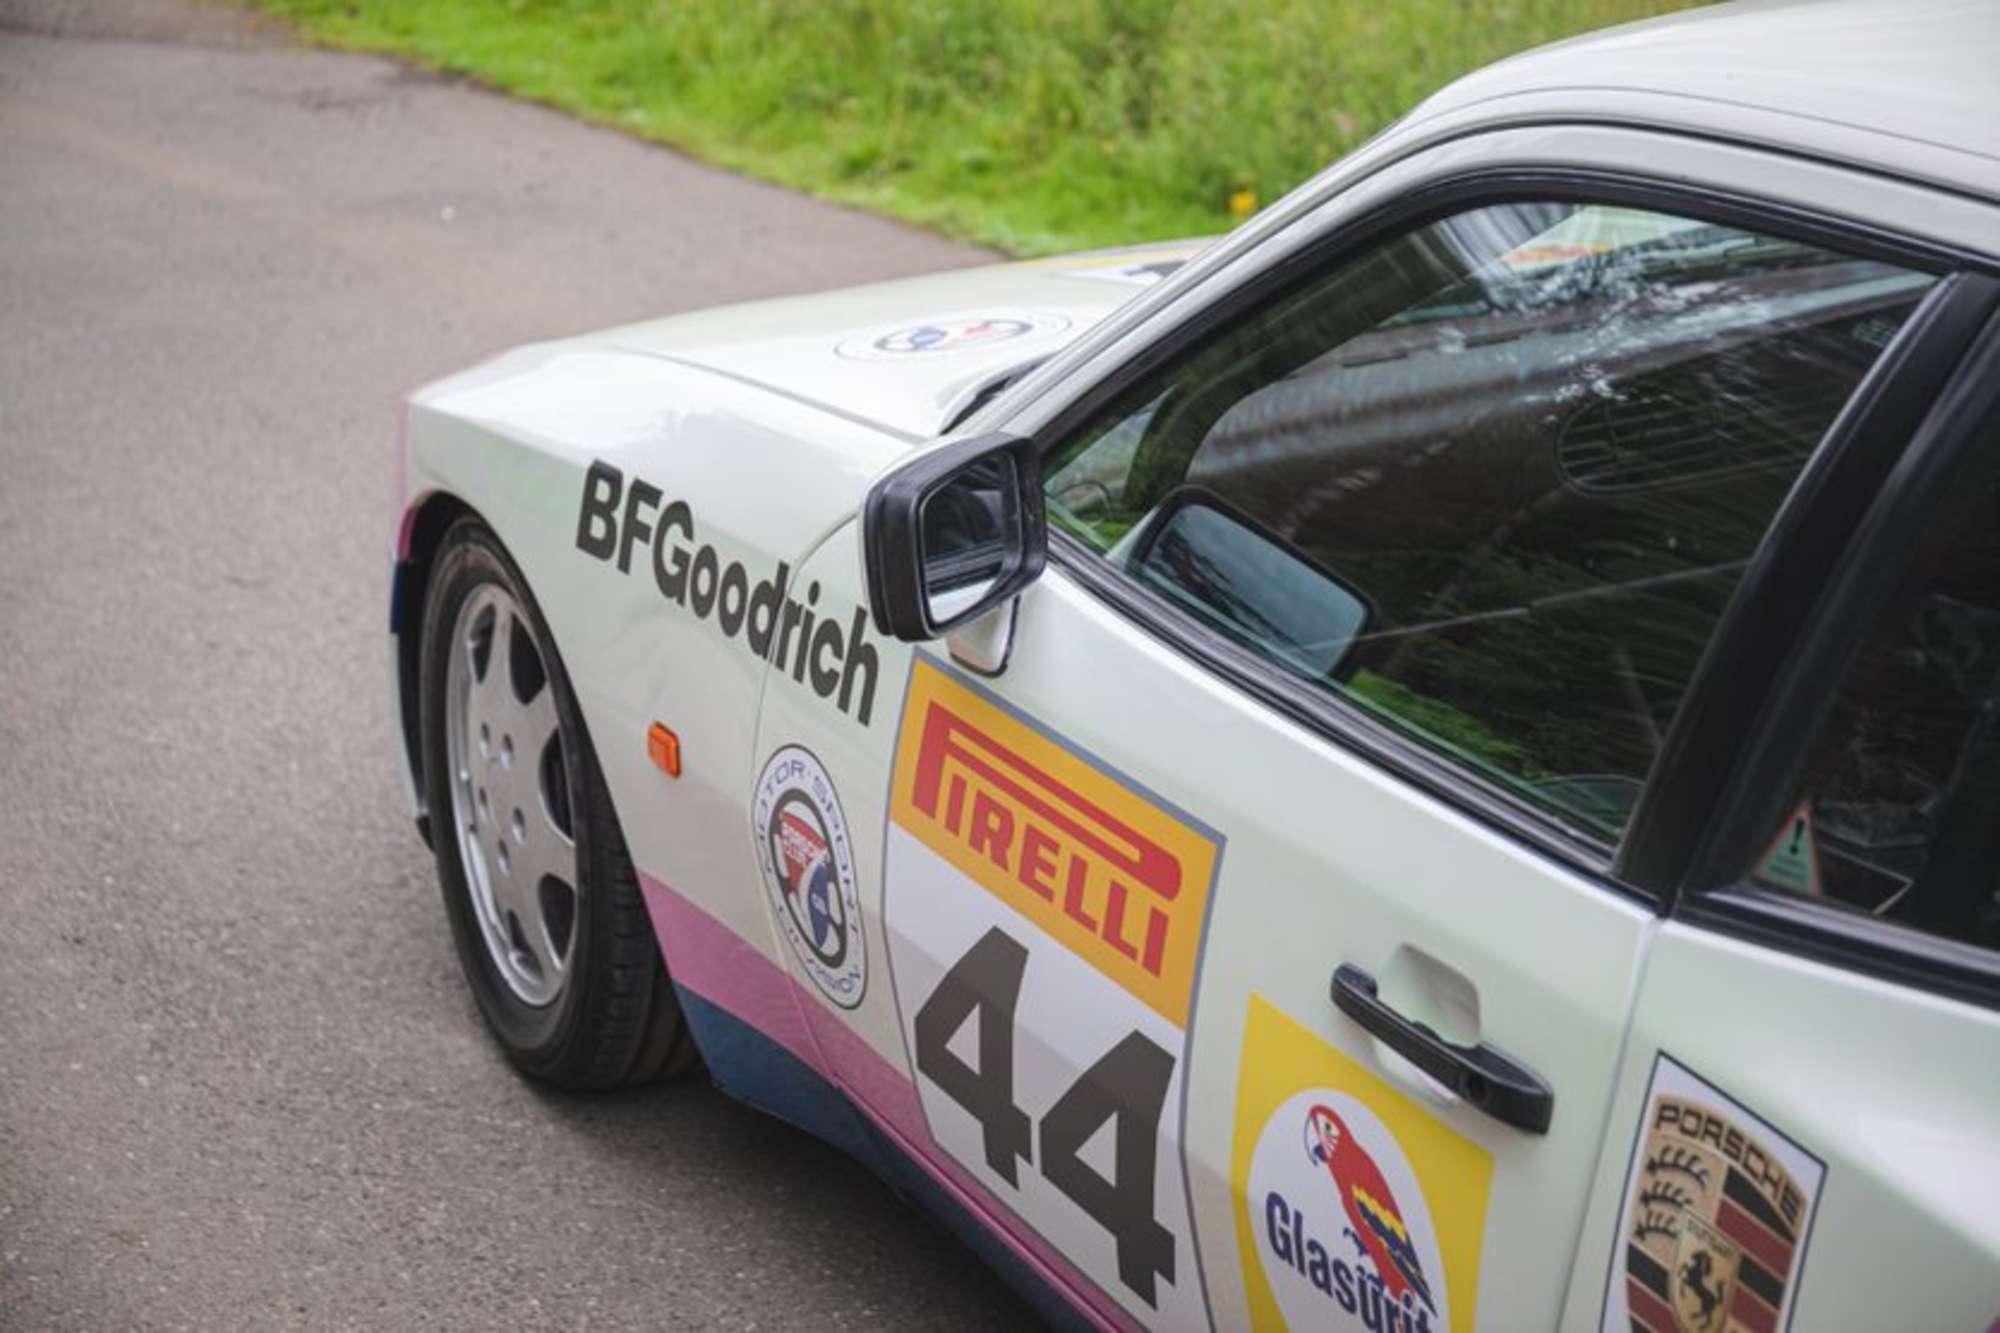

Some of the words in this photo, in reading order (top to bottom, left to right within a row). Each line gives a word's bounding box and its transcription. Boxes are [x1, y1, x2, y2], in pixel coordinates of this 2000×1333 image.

[576, 458, 880, 728] BFGoodrich
[911, 700, 1183, 979] PIRELLI
[914, 925, 1177, 1311] 44
[1655, 1103, 1801, 1228] PORSCHE
